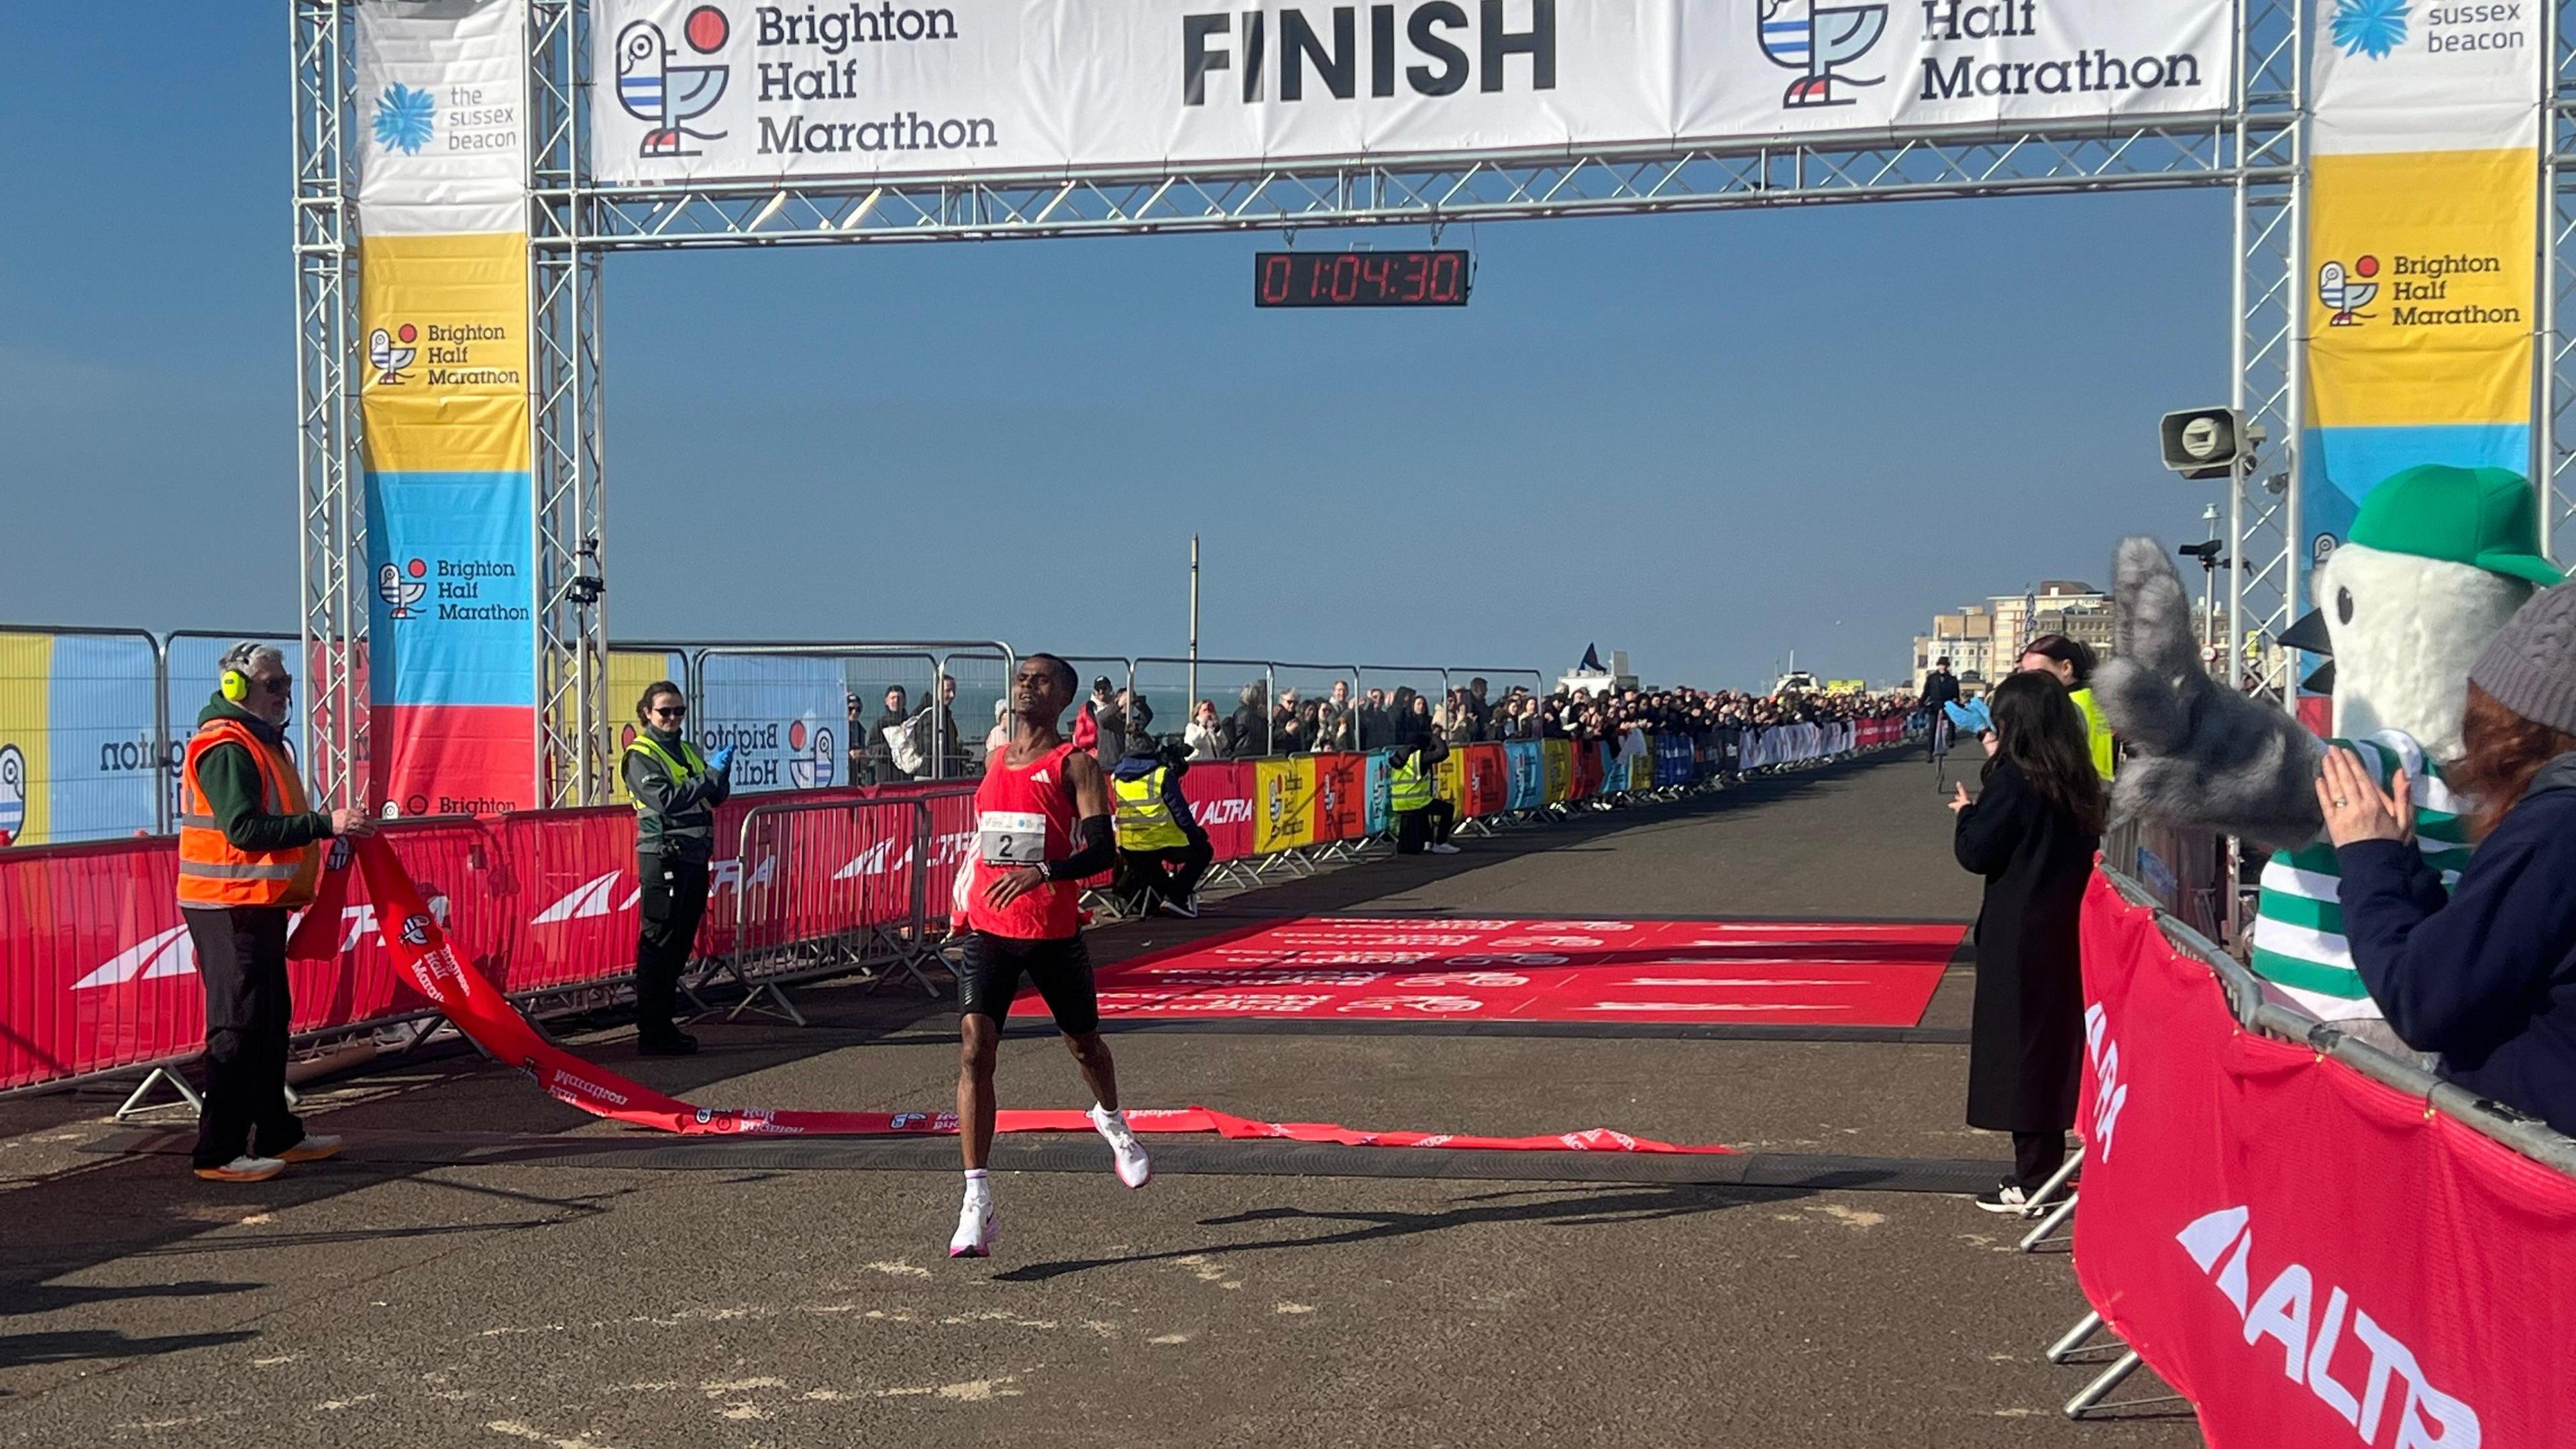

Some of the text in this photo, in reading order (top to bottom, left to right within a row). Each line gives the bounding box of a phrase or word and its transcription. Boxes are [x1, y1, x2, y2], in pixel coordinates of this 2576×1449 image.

[2428, 3, 2521, 25] sussex
[756, 3, 957, 54] Brighton
[2428, 30, 2524, 53] beacon
[1183, 0, 1556, 106] FINISH
[757, 59, 857, 103] Half
[1921, 50, 2200, 100] Marathon
[450, 86, 482, 106] the
[449, 107, 513, 125] sussex
[449, 130, 516, 150] beacon
[757, 112, 998, 155] Marathon
[2393, 254, 2501, 278] Brighton
[2392, 280, 2447, 301] Half
[2392, 305, 2521, 326] Marathon
[427, 323, 506, 345] Brighton
[427, 346, 468, 364] Half
[427, 368, 520, 385] Marathon
[437, 559, 516, 580] Brighton
[437, 582, 478, 598] Half
[437, 603, 530, 621] Marathon
[439, 796, 516, 816] Brighton
[1197, 798, 1253, 827] ALTRA
[999, 835, 1013, 857] 2
